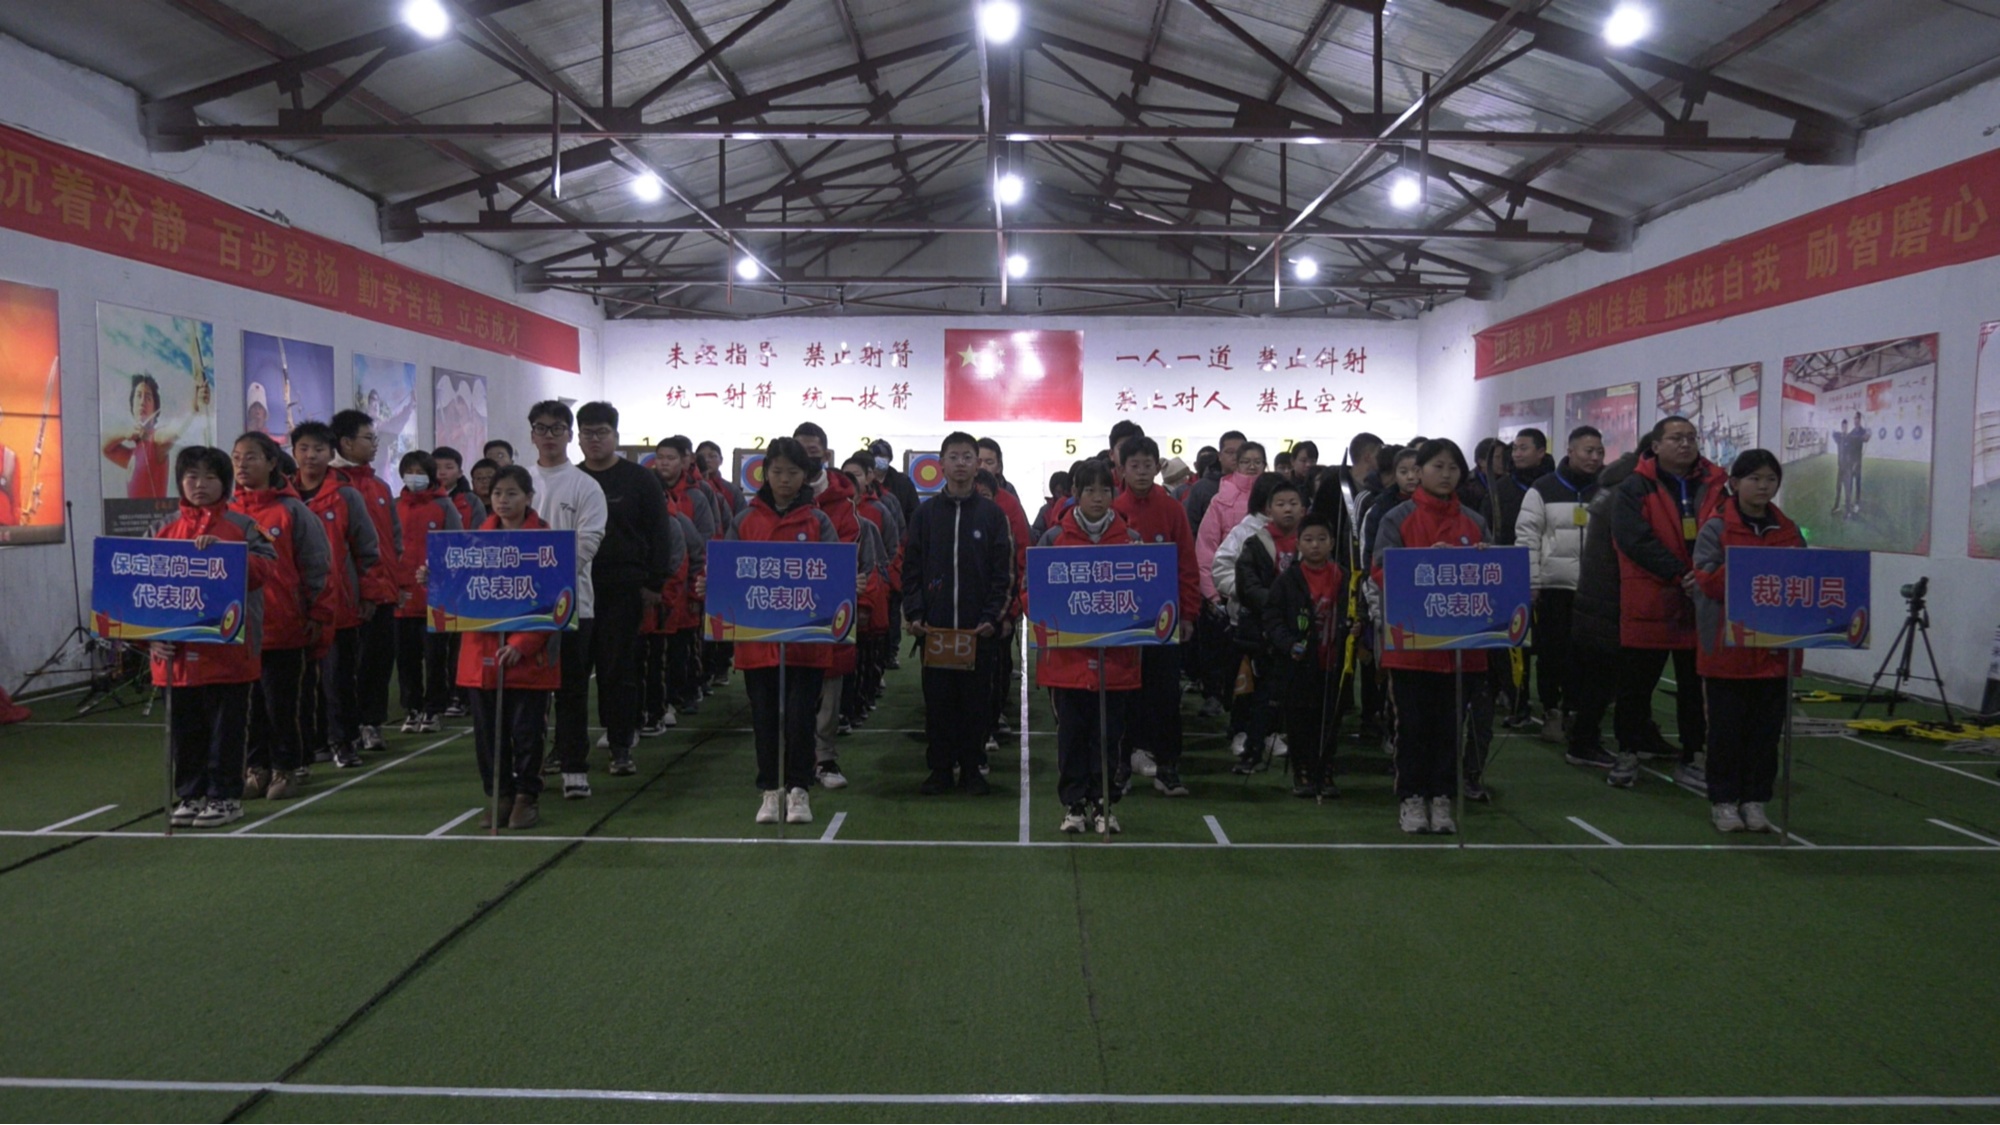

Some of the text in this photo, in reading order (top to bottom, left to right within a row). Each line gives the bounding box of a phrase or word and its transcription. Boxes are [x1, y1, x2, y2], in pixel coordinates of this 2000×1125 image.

[0, 147, 521, 348] 沉着冷静 百步穿杨 勤学苦练 立志成才
[1493, 183, 1989, 365] 团结努力 争创佳绩 挑战自我 励智磨心
[665, 339, 914, 370] 未经指导 禁止射箭
[1115, 345, 1368, 375] 一人一道 禁止斜射
[665, 381, 777, 410] 统一射箭
[1256, 387, 1368, 415] 禁止空放
[1065, 439, 1077, 454] 5
[1171, 439, 1183, 454] 6
[1284, 439, 1295, 453] 7
[111, 552, 228, 580] 保定喜尚二队
[445, 545, 558, 569] 保定喜尚一队
[736, 557, 827, 580] 冀奕弓社
[1048, 559, 1158, 584] 蠡吾镇二中
[1414, 562, 1503, 586] 蠡县喜尚
[133, 583, 205, 611] 代表队
[467, 575, 537, 600] 代表队
[746, 586, 817, 611] 代表队
[1751, 574, 1847, 609] 裁判员
[1068, 590, 1139, 615] 代表队
[1424, 592, 1494, 617] 代表队
[928, 632, 973, 657] 3-B
